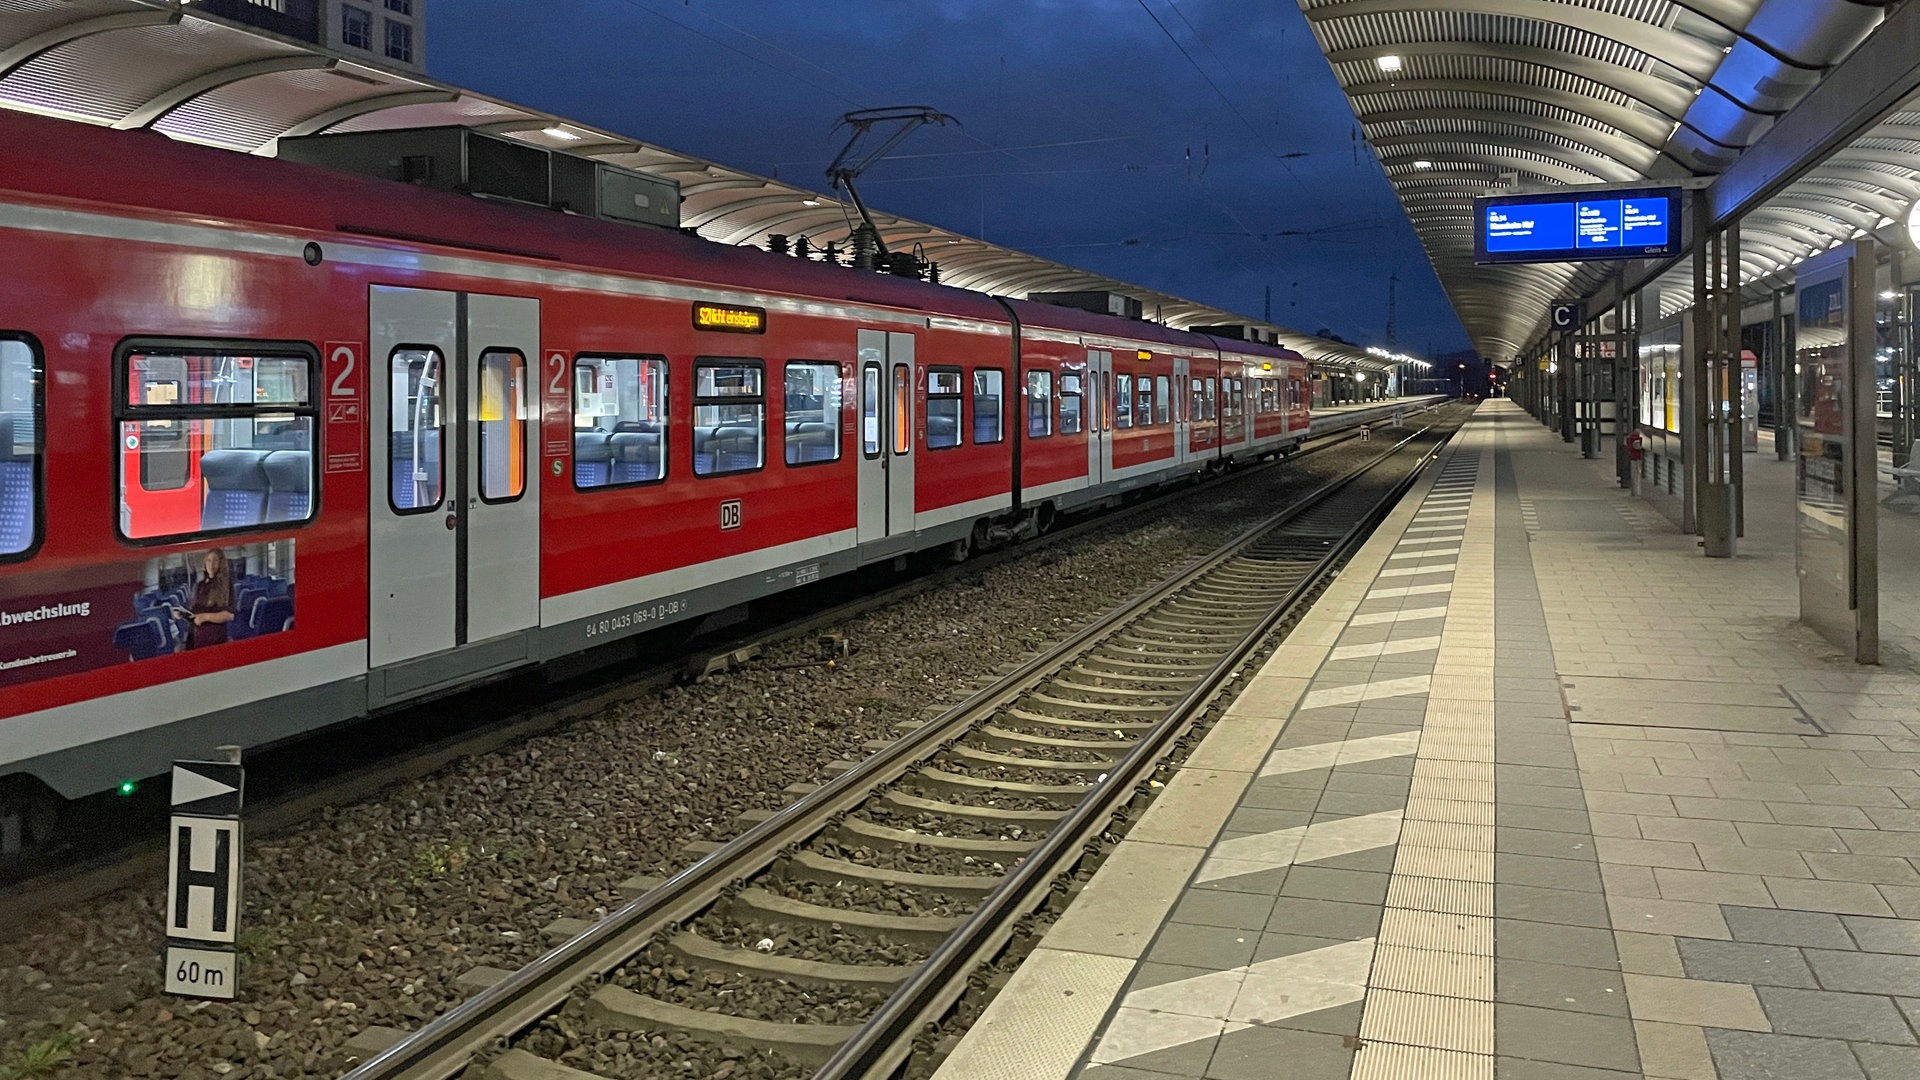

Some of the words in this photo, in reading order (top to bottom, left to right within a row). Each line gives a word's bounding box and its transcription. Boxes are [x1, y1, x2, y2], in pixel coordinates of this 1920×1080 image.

[1645, 246, 1661, 254] Gleis
[1554, 306, 1571, 326] C
[331, 346, 355, 396] 2
[549, 353, 566, 394] 2
[917, 365, 925, 391] 2
[1361, 430, 1369, 441] H
[553, 460, 563, 475] S
[723, 504, 739, 527] DB
[0, 602, 90, 626] bwechslung
[586, 623, 597, 638] 94
[599, 620, 609, 634] 80
[612, 614, 631, 631] 0435
[633, 606, 656, 624] 069-0
[659, 601, 679, 620] D-DB
[174, 824, 231, 933] H
[176, 960, 200, 984] 60
[204, 968, 223, 986] m
